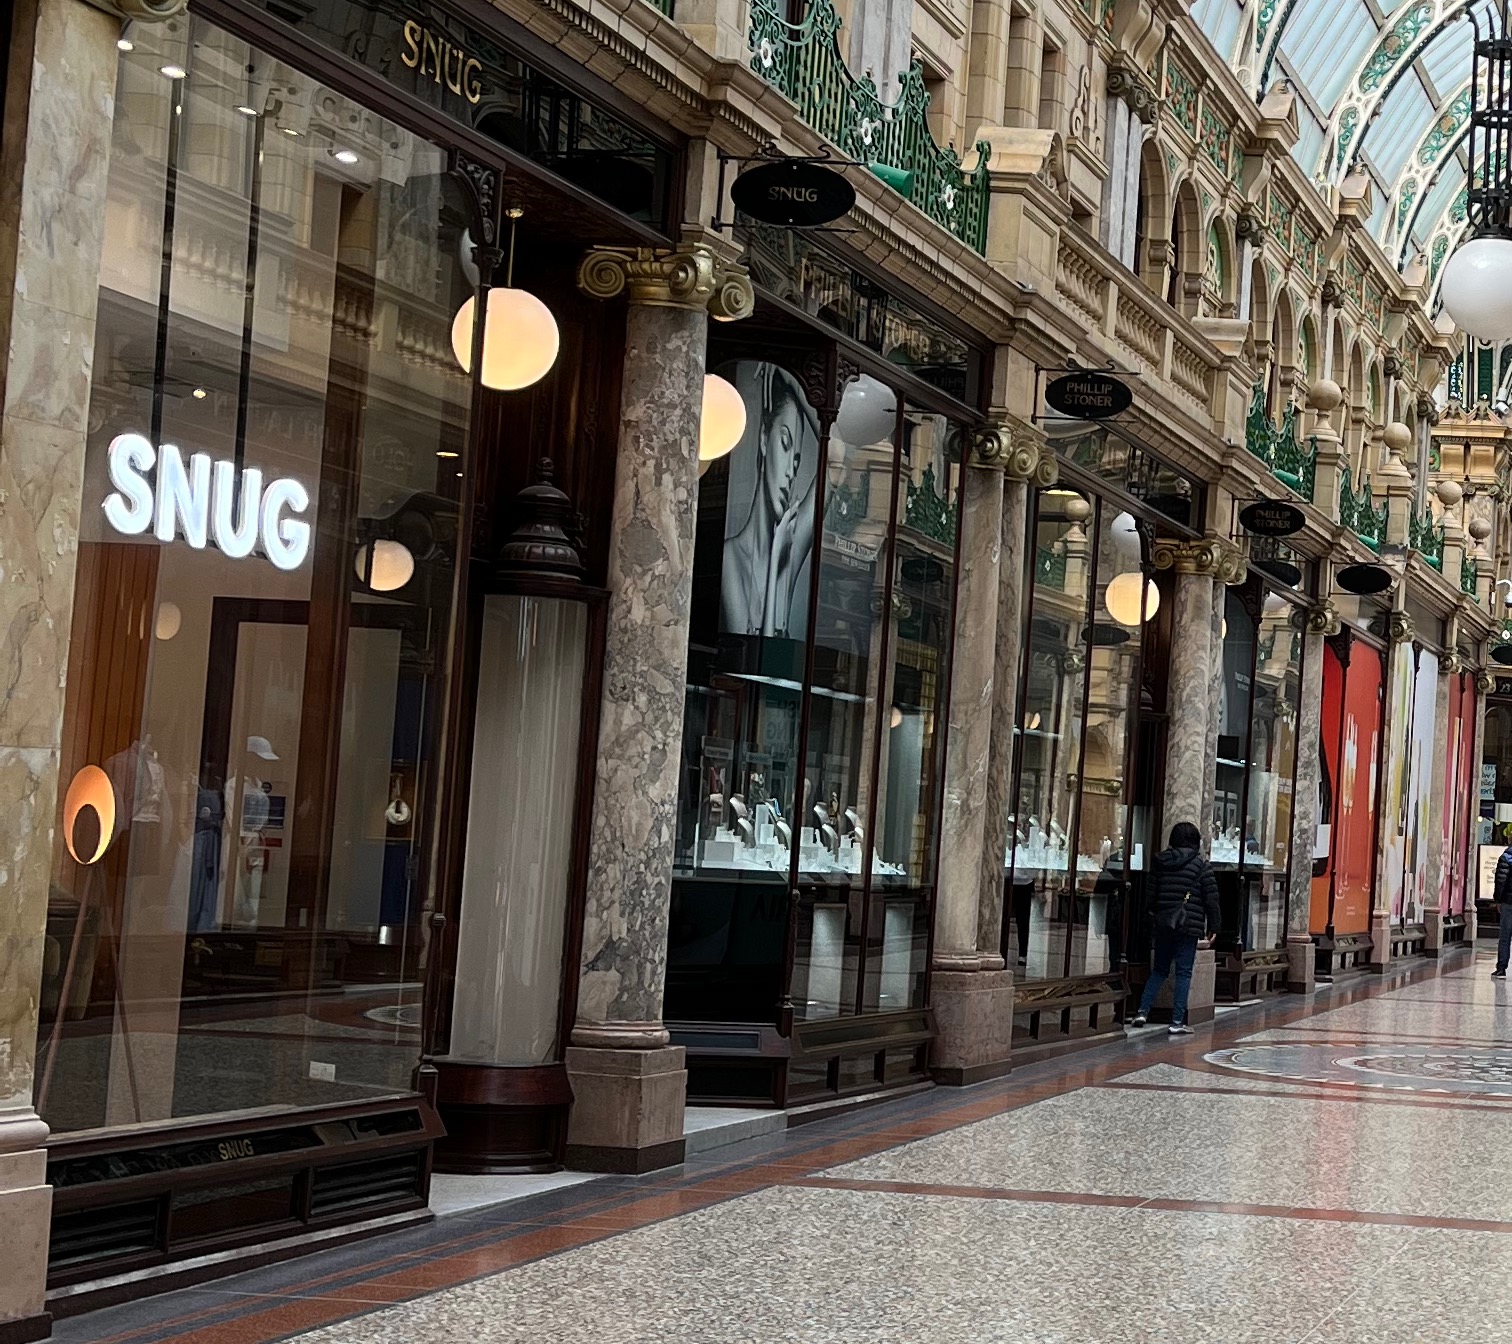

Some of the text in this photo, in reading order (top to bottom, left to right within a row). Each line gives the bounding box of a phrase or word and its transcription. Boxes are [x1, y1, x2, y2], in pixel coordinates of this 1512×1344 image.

[401, 19, 483, 104] SNUG
[768, 186, 819, 202] SNUG
[1066, 382, 1113, 394] PHILLIP
[1063, 394, 1113, 407] STONER
[101, 433, 311, 571] SNUG
[1500, 682, 1512, 693] 23
[218, 1138, 255, 1161] SNUG
